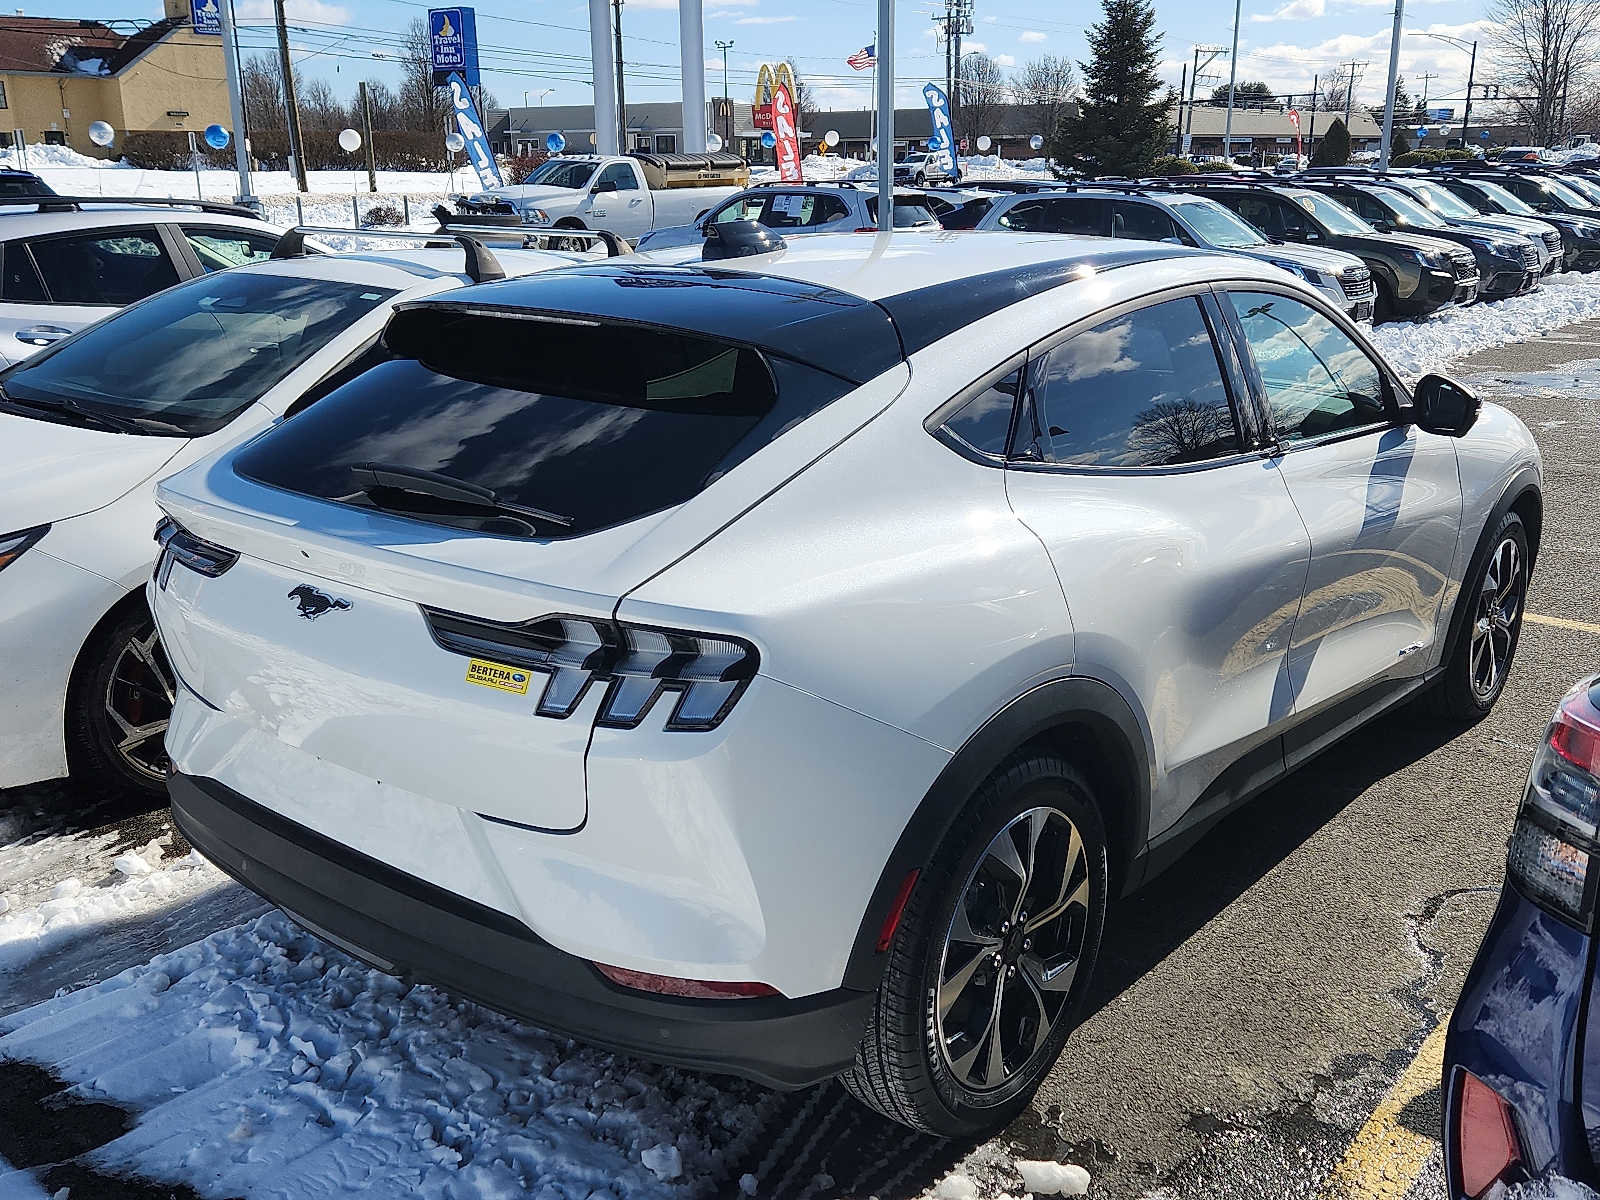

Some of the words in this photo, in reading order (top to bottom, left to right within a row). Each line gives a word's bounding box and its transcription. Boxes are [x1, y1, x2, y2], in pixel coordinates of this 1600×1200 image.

[434, 34, 461, 45] Travel
[440, 45, 455, 53] Inn
[436, 53, 461, 64] Motel
[470, 664, 511, 681] BERTERA
[469, 673, 497, 684] SUBARU
